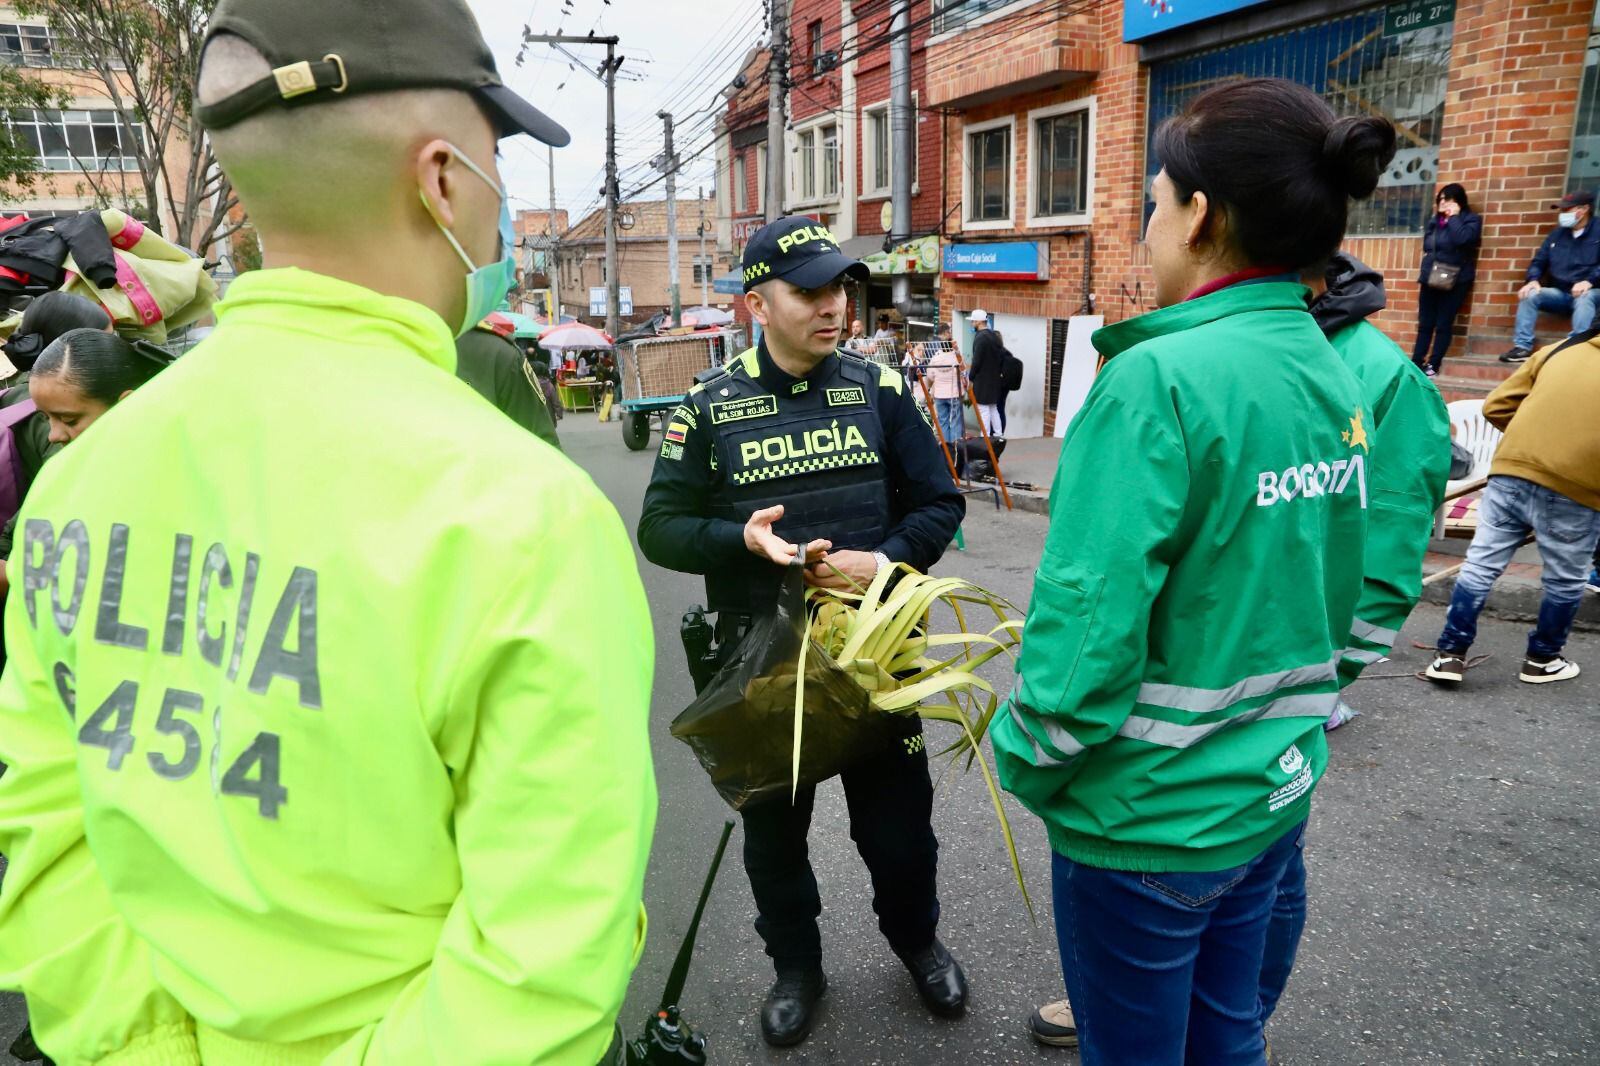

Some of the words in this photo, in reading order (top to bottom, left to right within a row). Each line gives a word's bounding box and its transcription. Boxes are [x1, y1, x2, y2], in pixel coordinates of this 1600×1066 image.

[1394, 12, 1422, 28] Calle
[981, 253, 997, 263] Social
[718, 409, 744, 420] WILSON
[746, 405, 771, 416] ROJAS
[740, 419, 868, 466] POLICÍA
[23, 518, 322, 710] POLICIA
